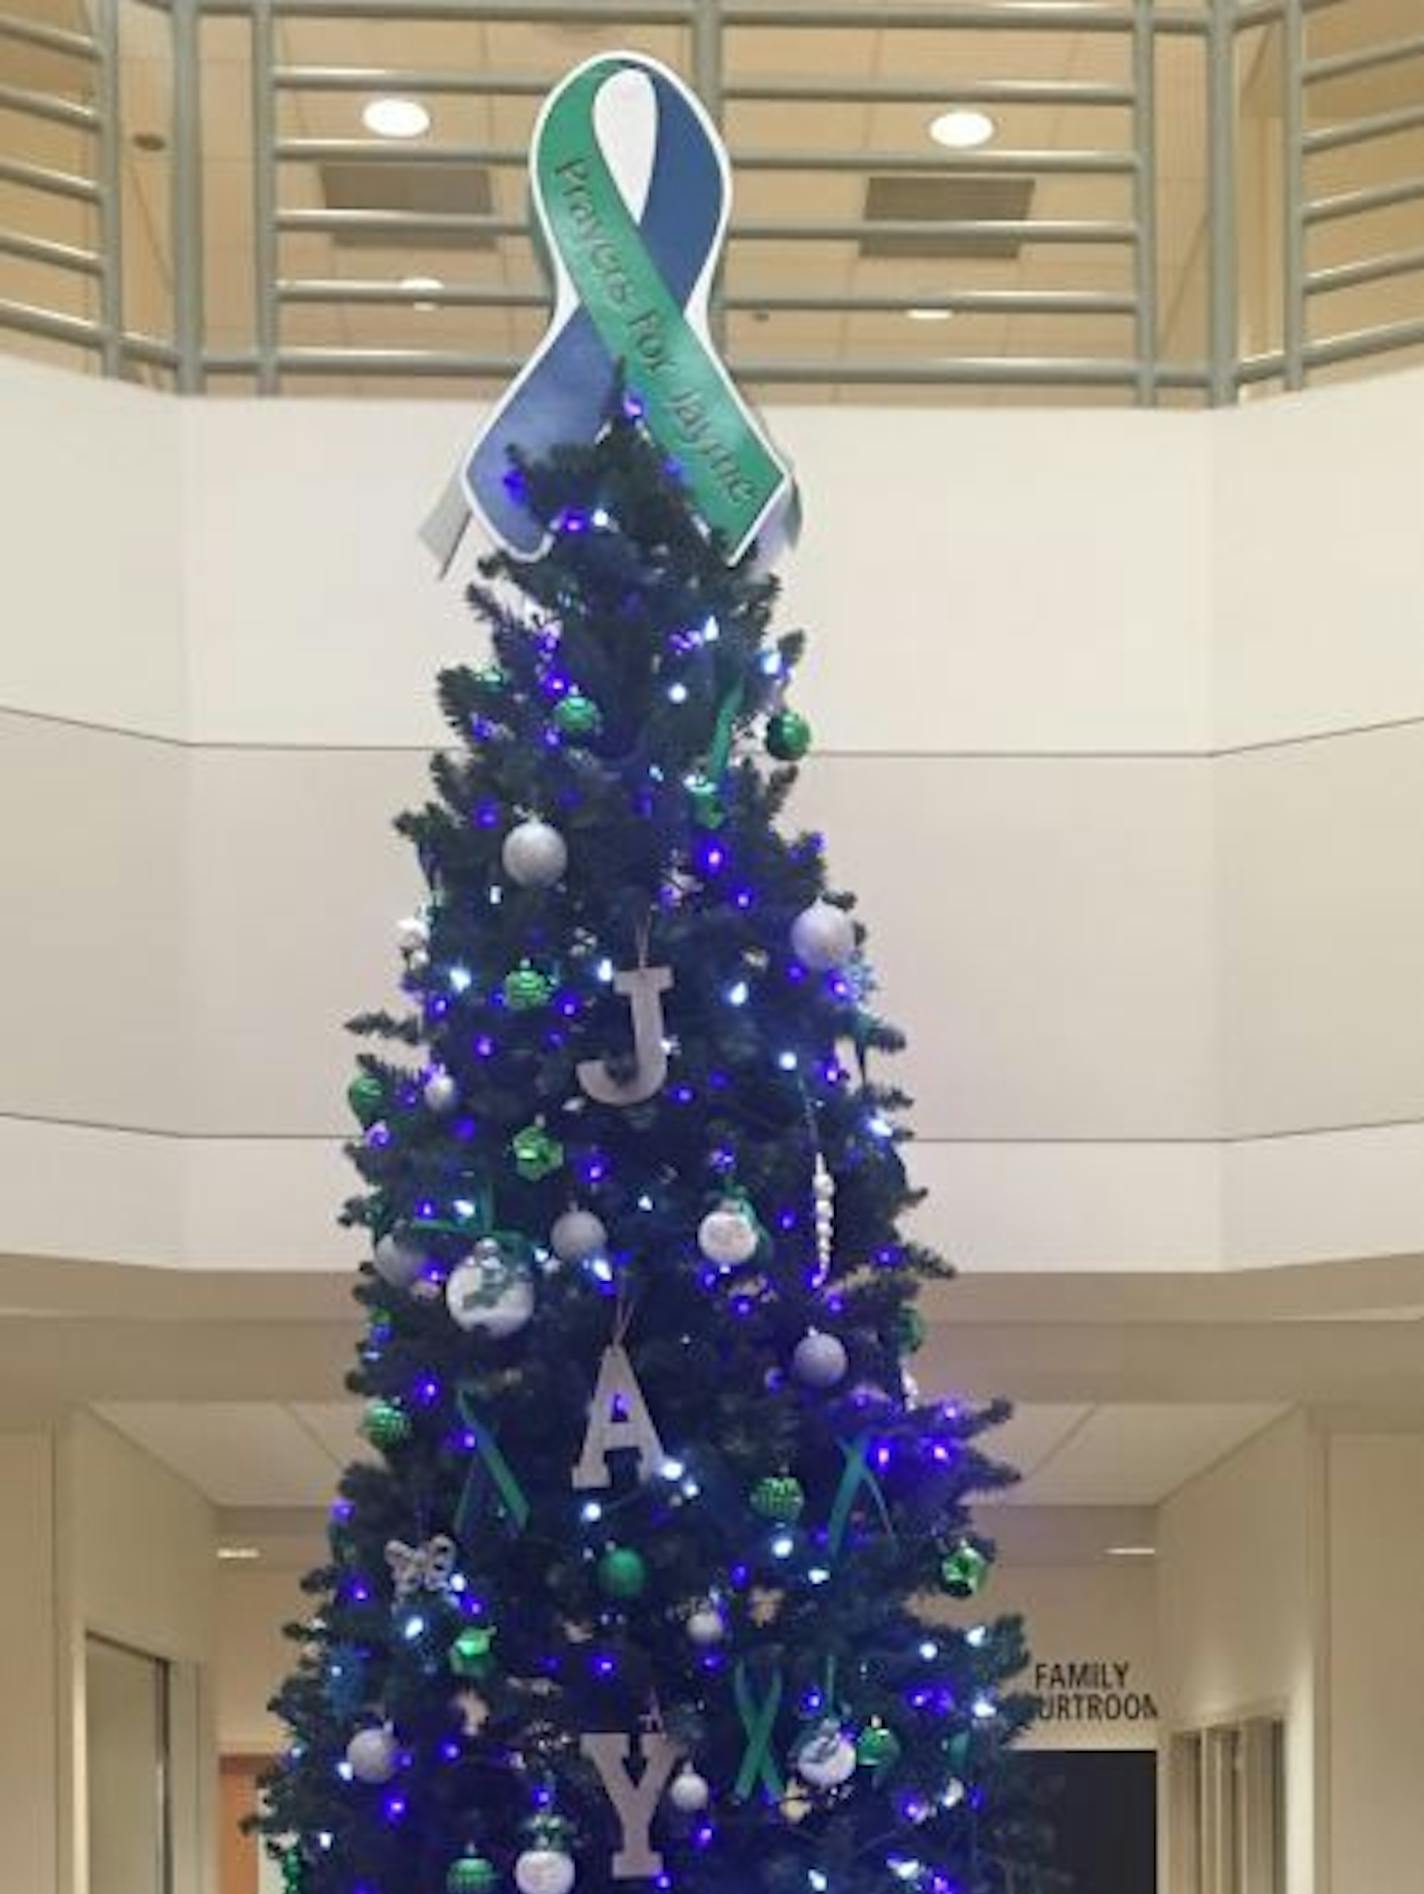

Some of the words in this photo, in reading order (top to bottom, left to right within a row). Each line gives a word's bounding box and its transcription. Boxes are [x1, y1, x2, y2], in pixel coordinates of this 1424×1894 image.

[555, 158, 635, 303] Prayers
[668, 388, 756, 504] Jayme
[1035, 1662, 1129, 1690] FAMILY
